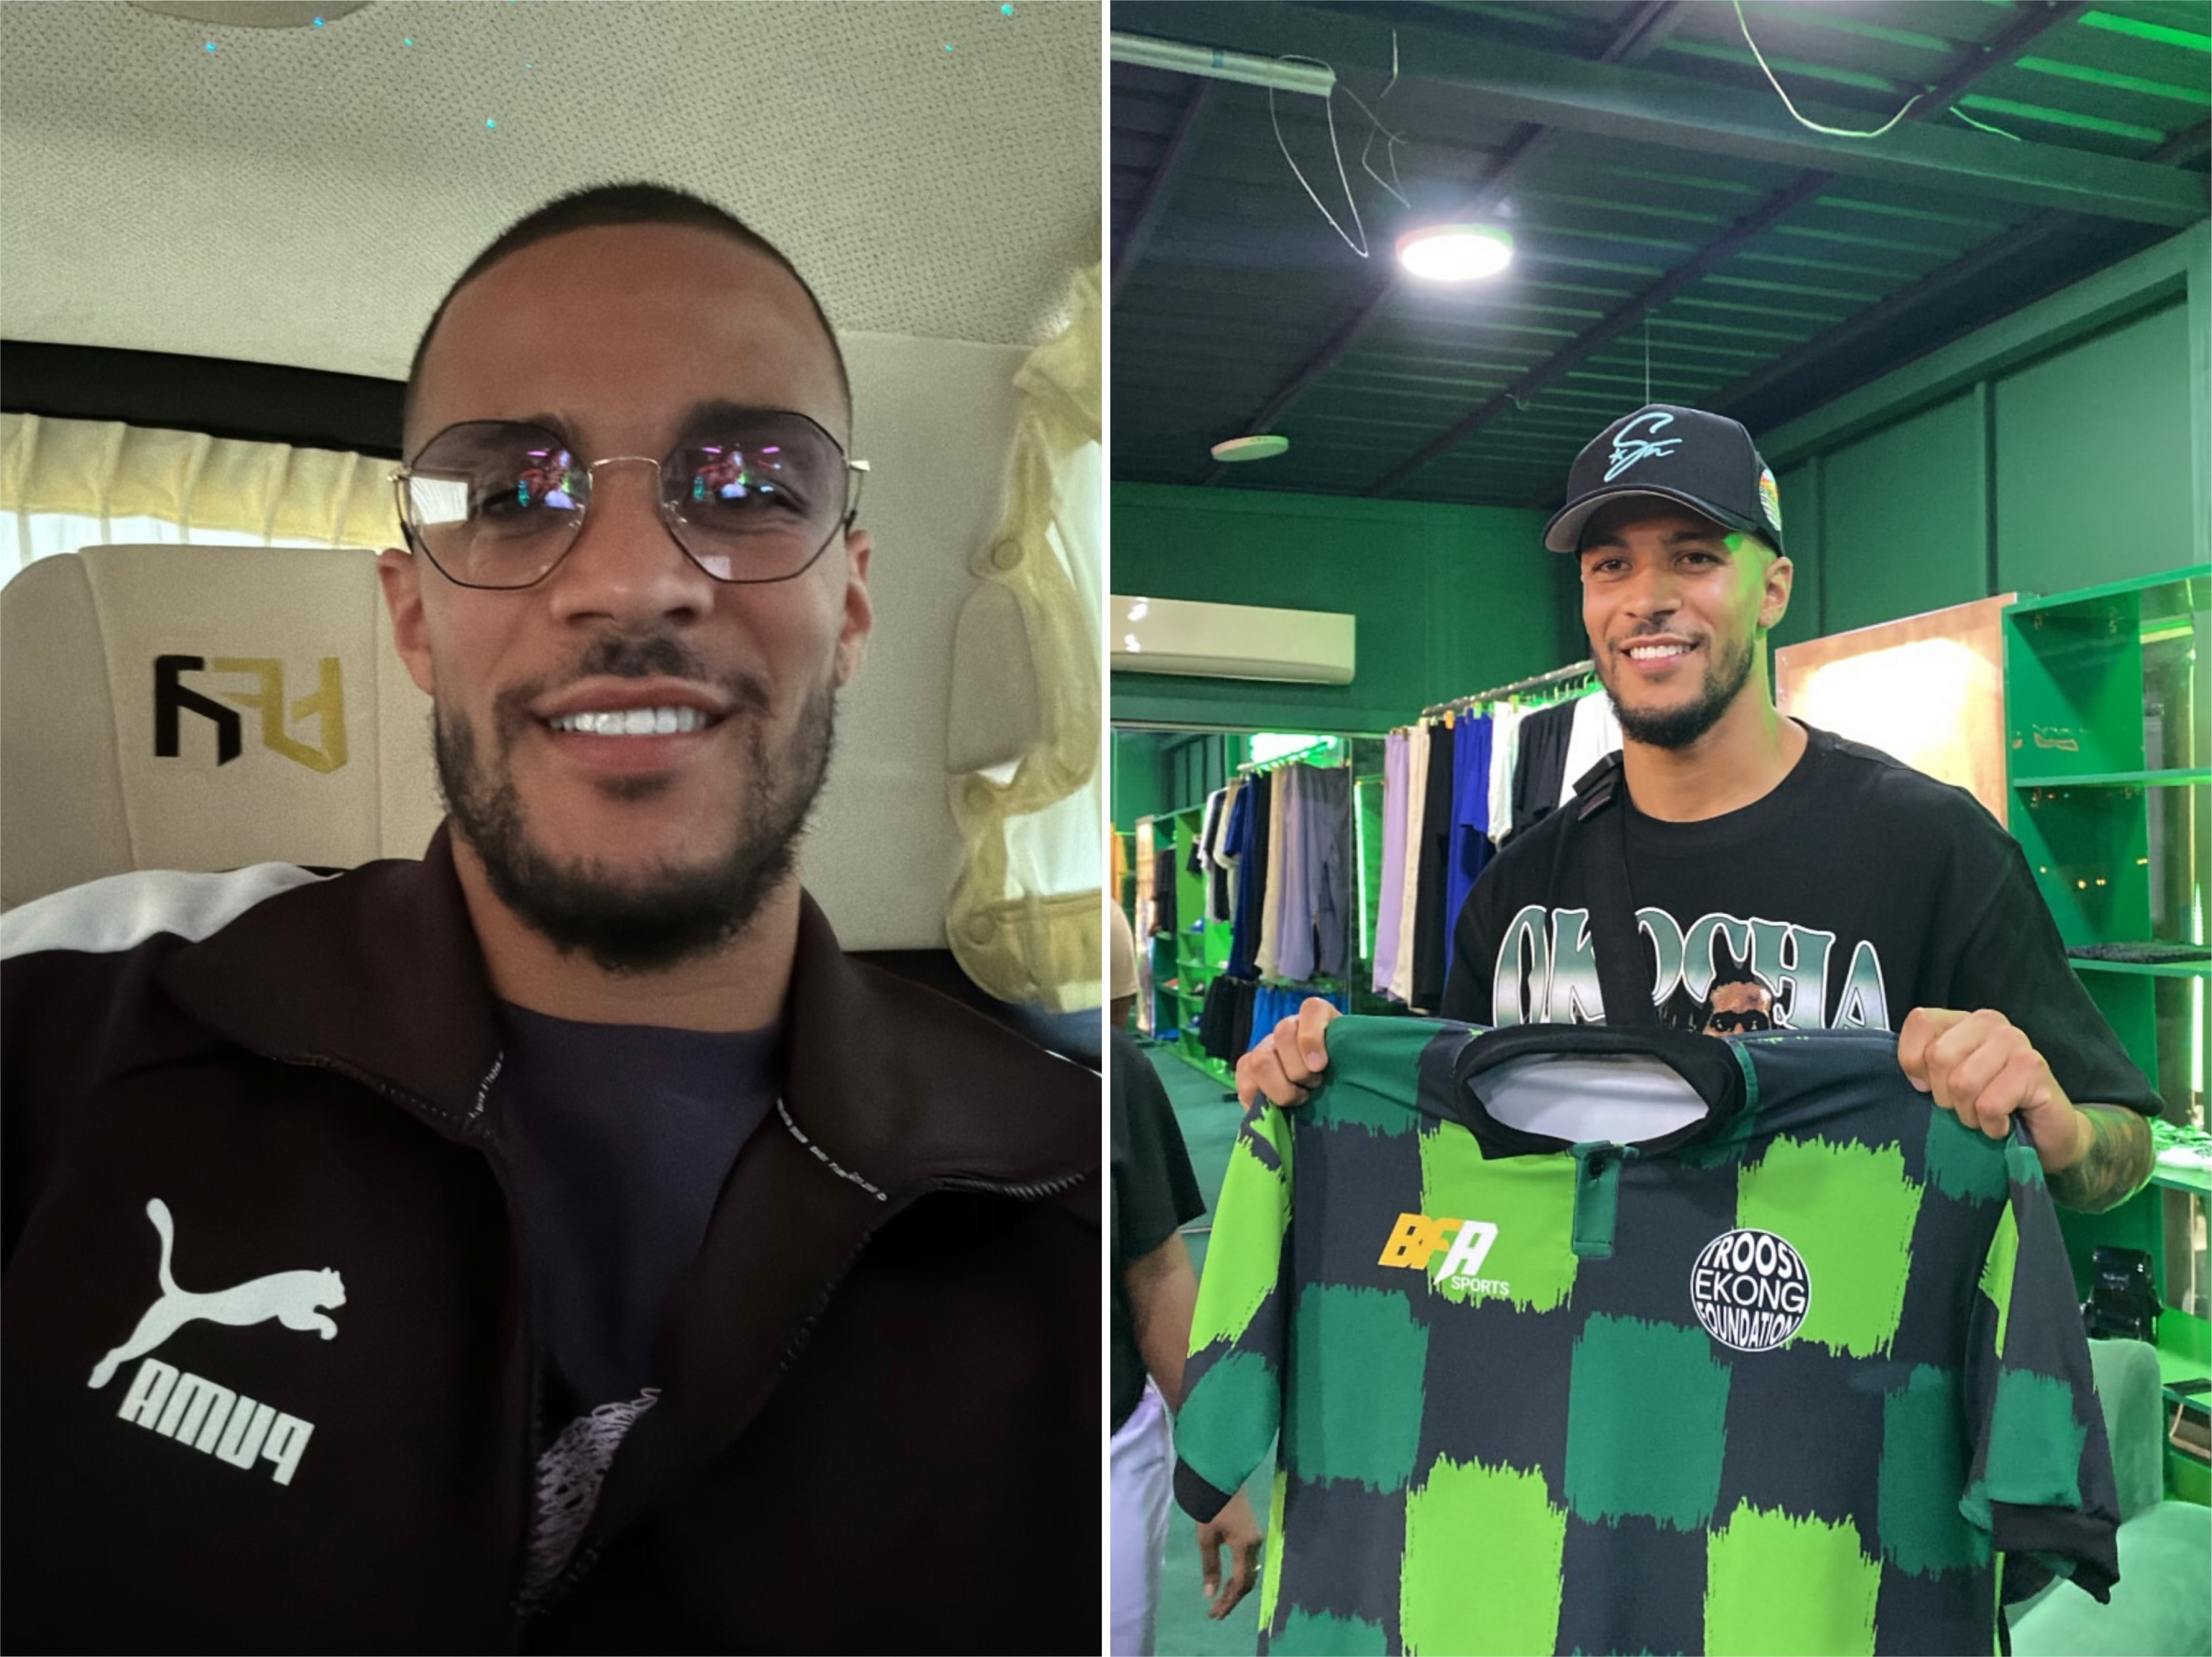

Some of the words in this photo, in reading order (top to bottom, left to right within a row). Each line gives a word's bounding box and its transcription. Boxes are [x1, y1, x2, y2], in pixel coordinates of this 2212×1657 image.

[1378, 1213, 1498, 1284] BFA
[1701, 1232, 1803, 1280] TROOST
[1451, 1275, 1510, 1295] SPORTS
[1695, 1269, 1805, 1314] EKONG
[1696, 1302, 1800, 1348] FOUNDATION
